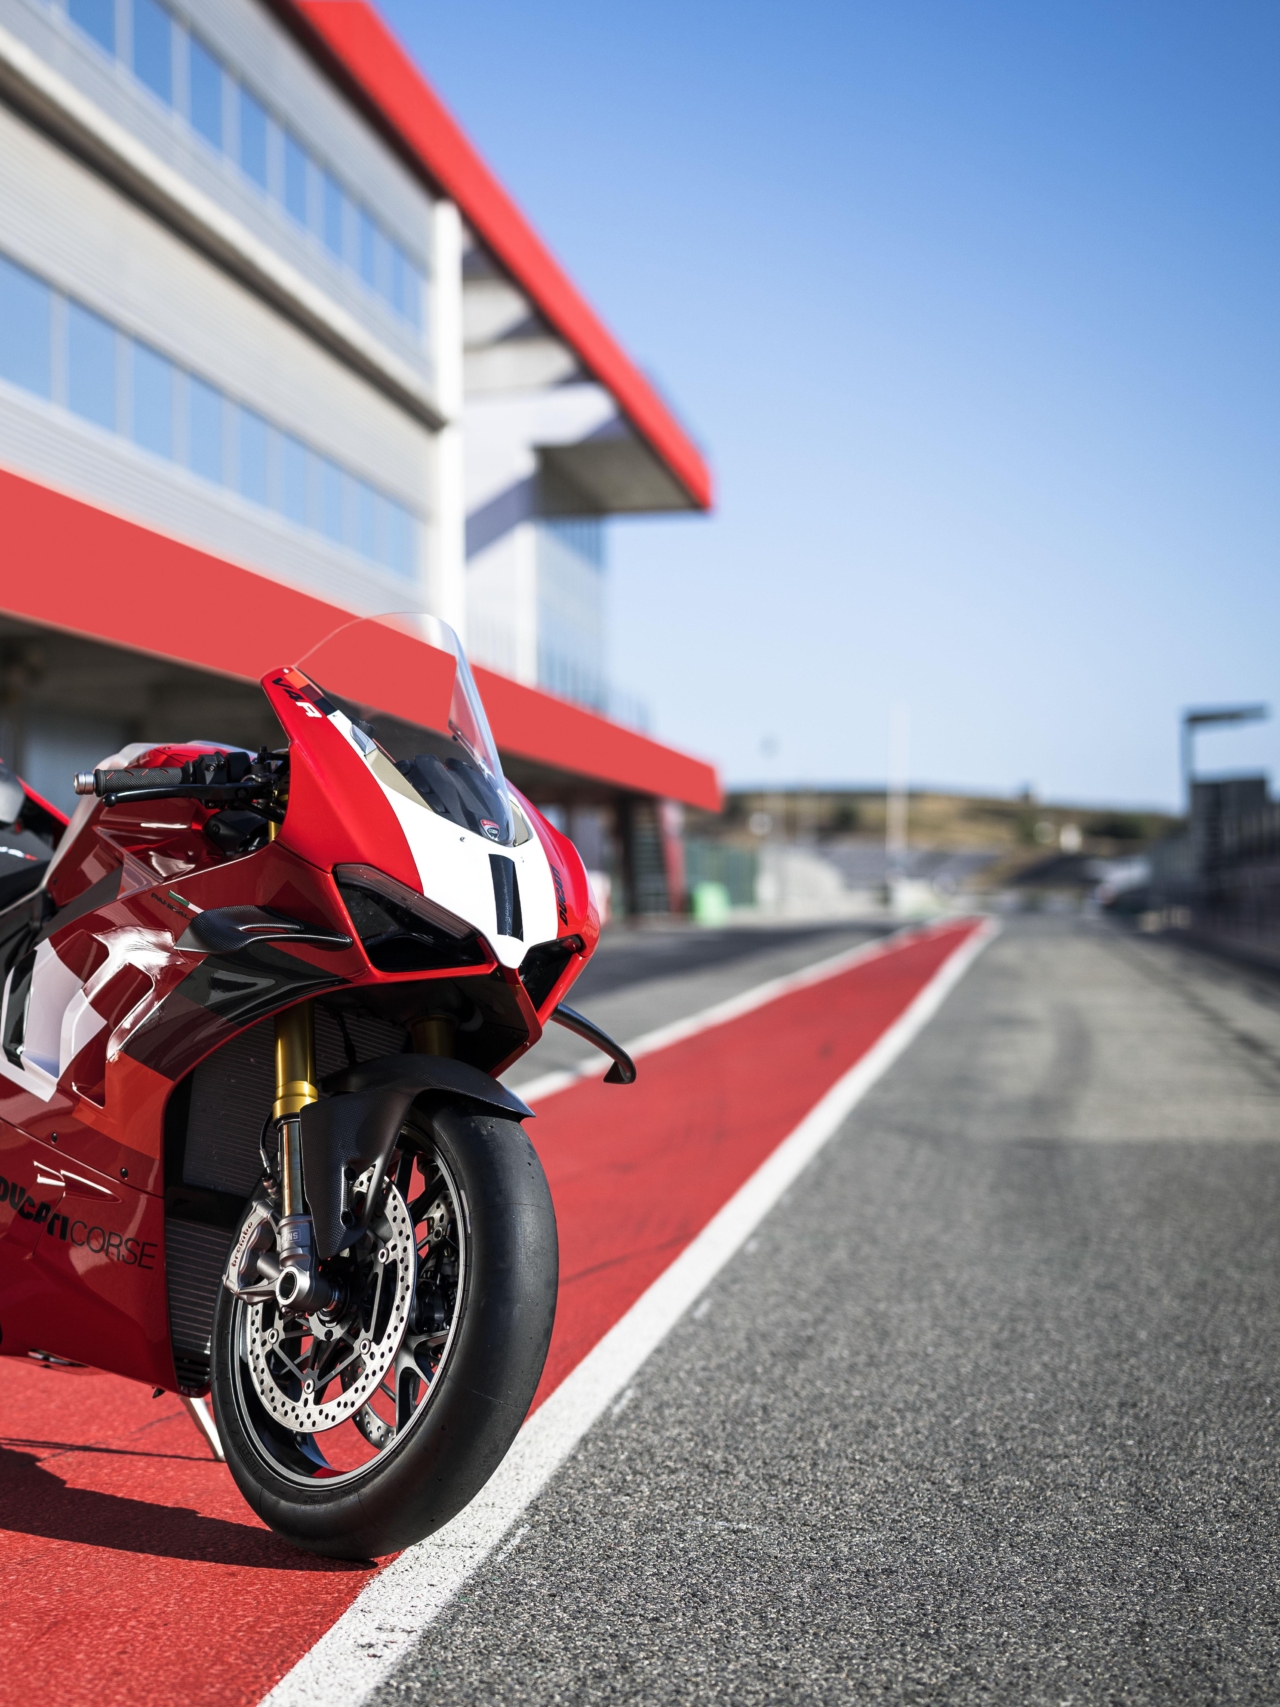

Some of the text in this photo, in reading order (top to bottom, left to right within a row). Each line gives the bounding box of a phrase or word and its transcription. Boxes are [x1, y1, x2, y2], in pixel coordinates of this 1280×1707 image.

[550, 863, 568, 927] DUCATI
[70, 1220, 158, 1270] CORSE
[231, 1222, 253, 1267] brembo
